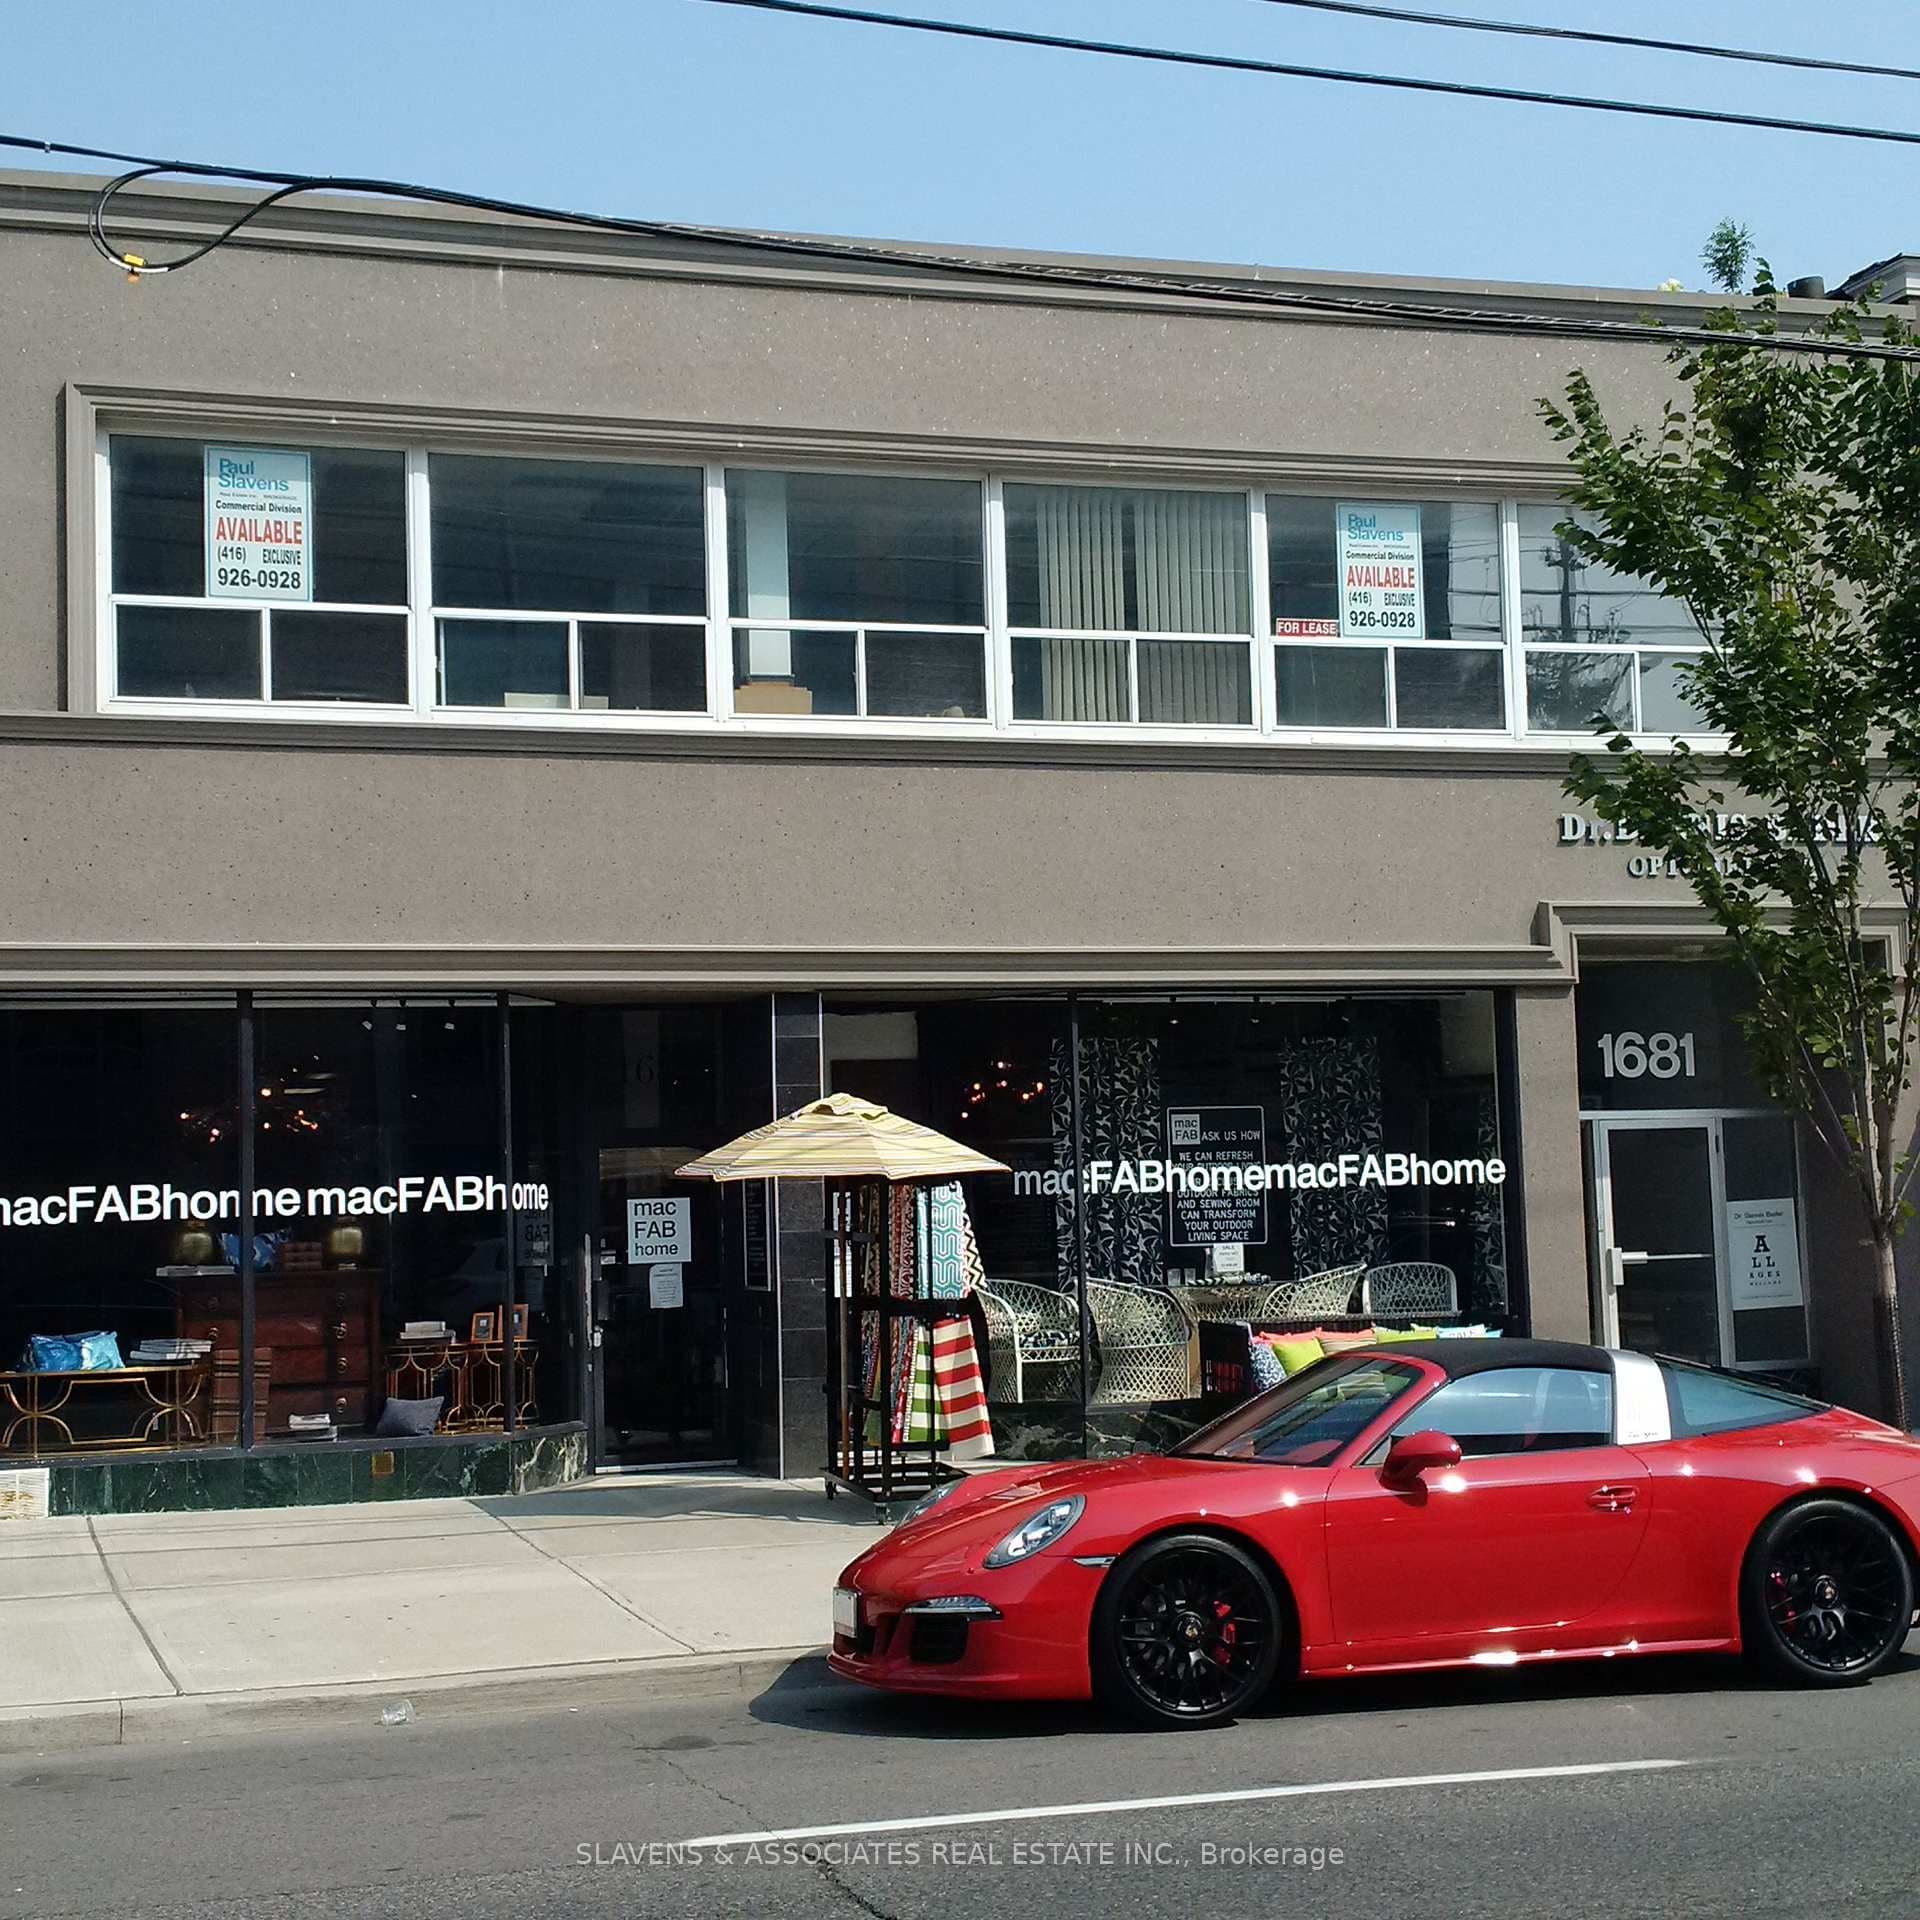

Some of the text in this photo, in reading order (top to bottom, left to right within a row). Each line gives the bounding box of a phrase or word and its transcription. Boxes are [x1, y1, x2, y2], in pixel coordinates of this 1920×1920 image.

[219, 458, 254, 475] Paul
[218, 473, 289, 491] Slavens
[216, 500, 302, 514] Commercial Division
[1348, 513, 1376, 528] Paul
[216, 517, 302, 544] AVAILABLE
[1347, 527, 1404, 542] Slavens
[217, 546, 301, 565] (416) EXCLUSIVE
[1346, 550, 1415, 561] Commercial Division
[217, 568, 301, 589] 926-0928
[1347, 565, 1415, 589] AVAILABLE
[1349, 591, 1415, 607] (416) EXCLUSIVE
[1349, 610, 1415, 628] 926-0928
[1278, 621, 1337, 634] FOR LEASE
[1598, 1032, 1695, 1078] 1681
[1174, 1119, 1198, 1129] mac
[1175, 1129, 1199, 1140] FAB
[1201, 1130, 1260, 1141] ASK US HOW
[1179, 1151, 1254, 1161] WE CAN REFRESH
[307, 1175, 549, 1216] macFABhome
[634, 1201, 677, 1216] mac
[1177, 1198, 1260, 1209] AND SEWING ROOM
[1181, 1209, 1256, 1219] CAN TRANSFORM
[635, 1220, 676, 1239] FAB
[1184, 1220, 1253, 1231] YOUR OUTDOOR
[1188, 1230, 1249, 1241] LIVING SPACE
[635, 1242, 678, 1256] home
[1754, 1235, 1770, 1252] A
